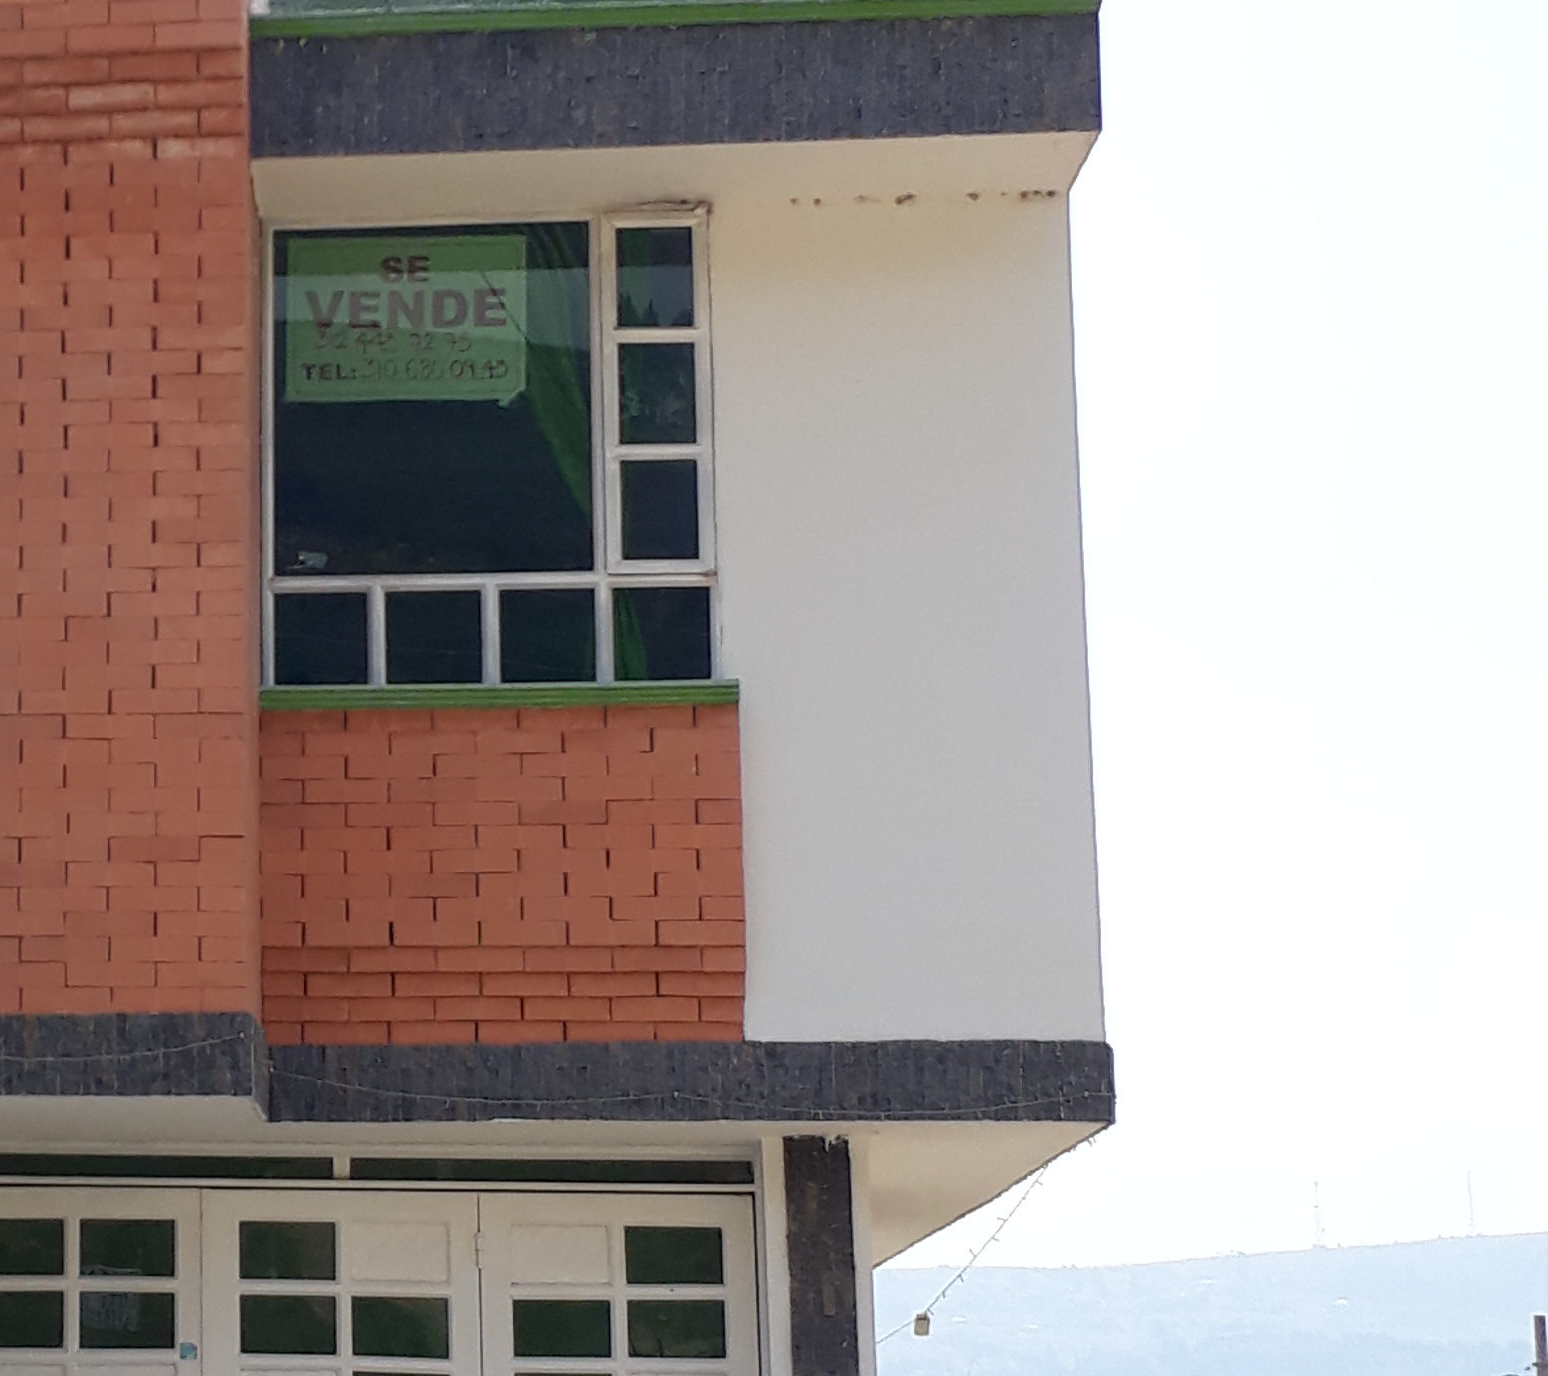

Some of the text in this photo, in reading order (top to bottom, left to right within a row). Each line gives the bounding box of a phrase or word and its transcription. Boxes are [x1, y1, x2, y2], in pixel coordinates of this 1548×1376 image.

[380, 255, 431, 284] SE
[305, 288, 508, 329] VENDE
[301, 360, 357, 382] TEL:
